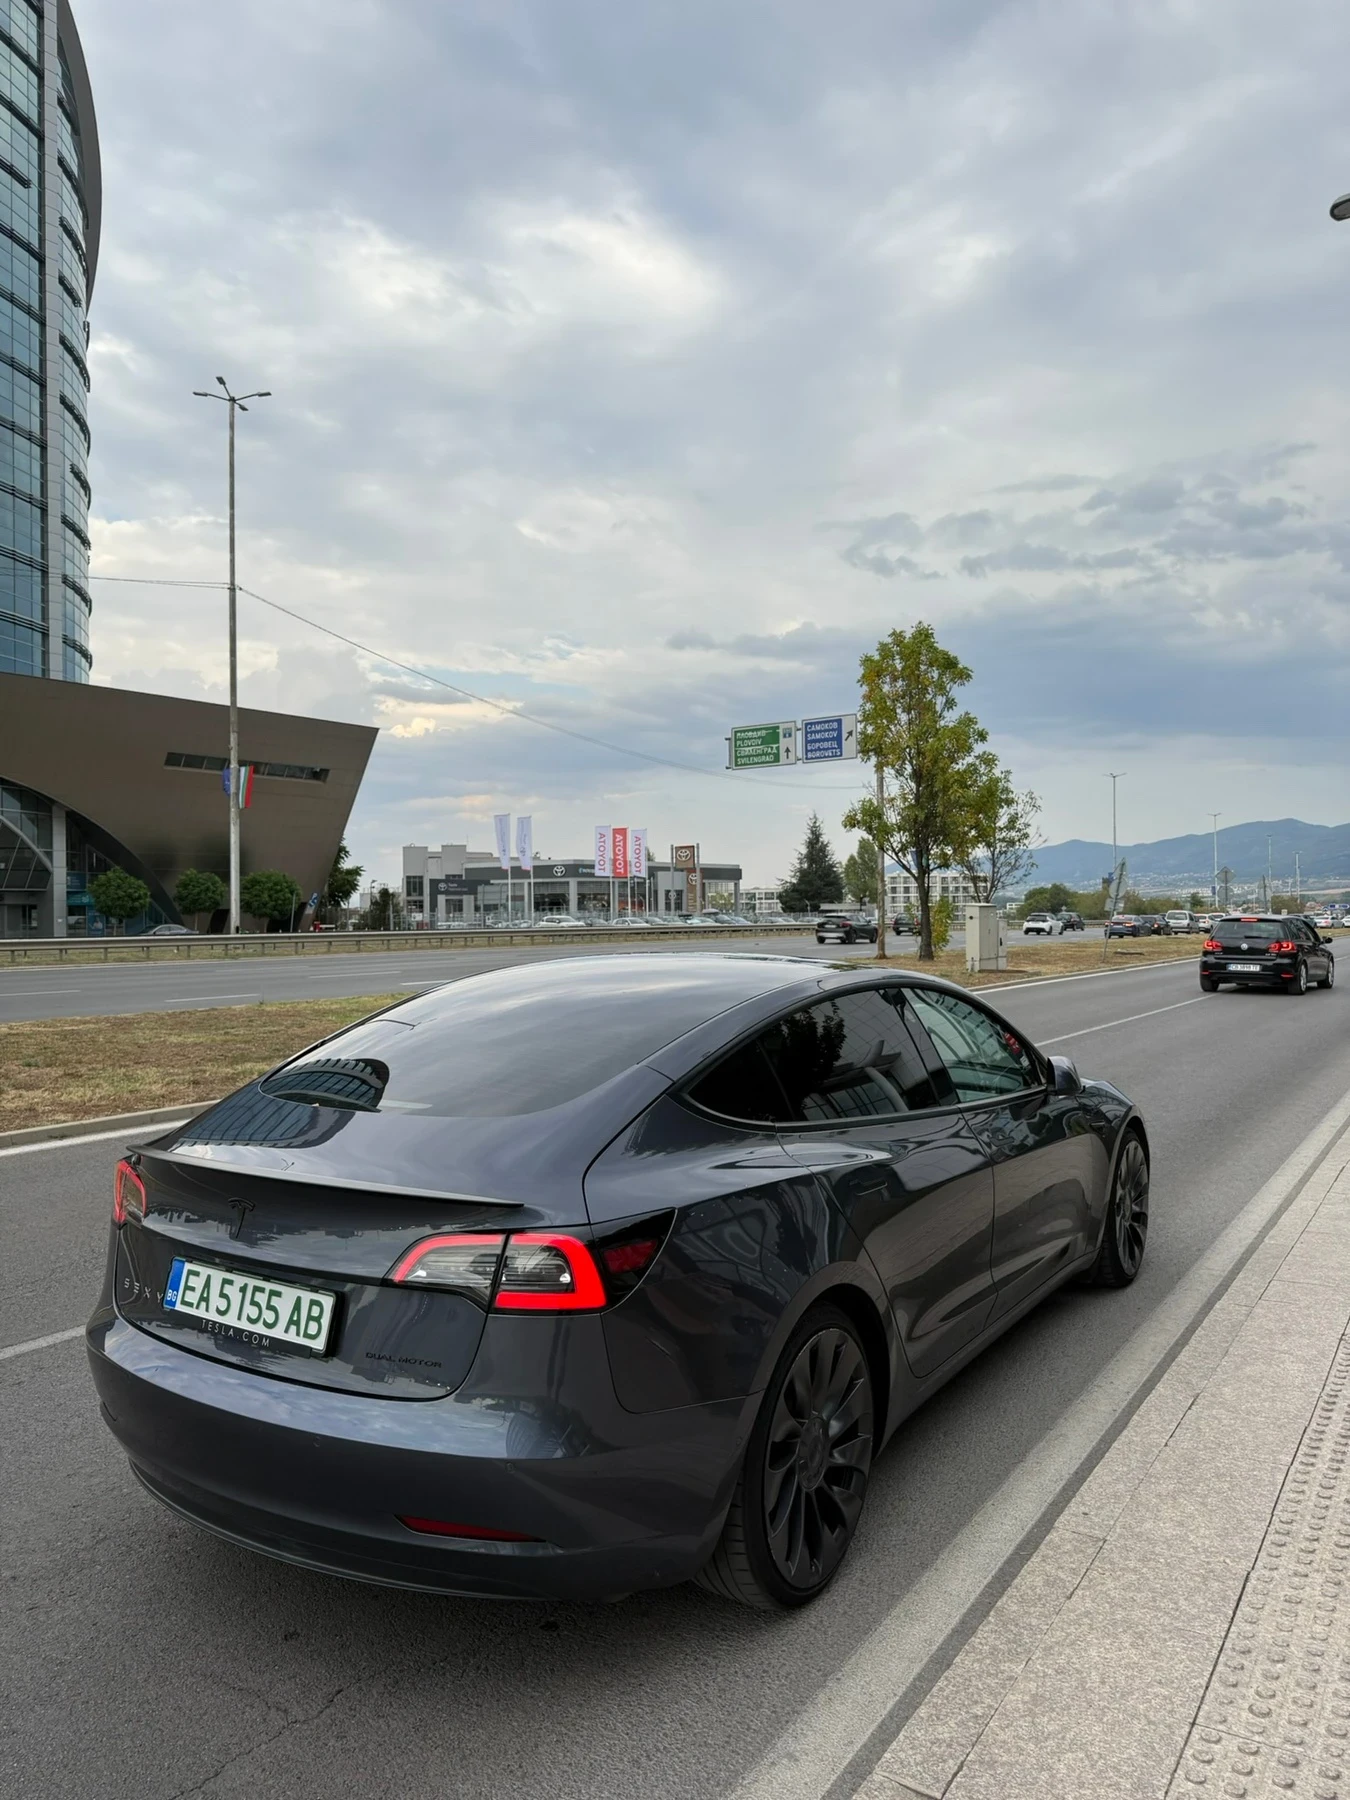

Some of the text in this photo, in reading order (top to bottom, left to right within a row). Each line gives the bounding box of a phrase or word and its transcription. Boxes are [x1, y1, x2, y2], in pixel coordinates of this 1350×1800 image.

[807, 722, 838, 732] САМОКОВ
[807, 731, 838, 740] SAMOKOV
[736, 738, 762, 747] PLOVDIV
[807, 740, 838, 751] БОРОВЕЦ
[807, 749, 841, 758] BOROVETS
[737, 754, 774, 765] SVILENGRAD
[167, 1289, 178, 1302] BG
[201, 1319, 270, 1347] TESLA.COM
[365, 1351, 442, 1368] DUAL MOTOR
